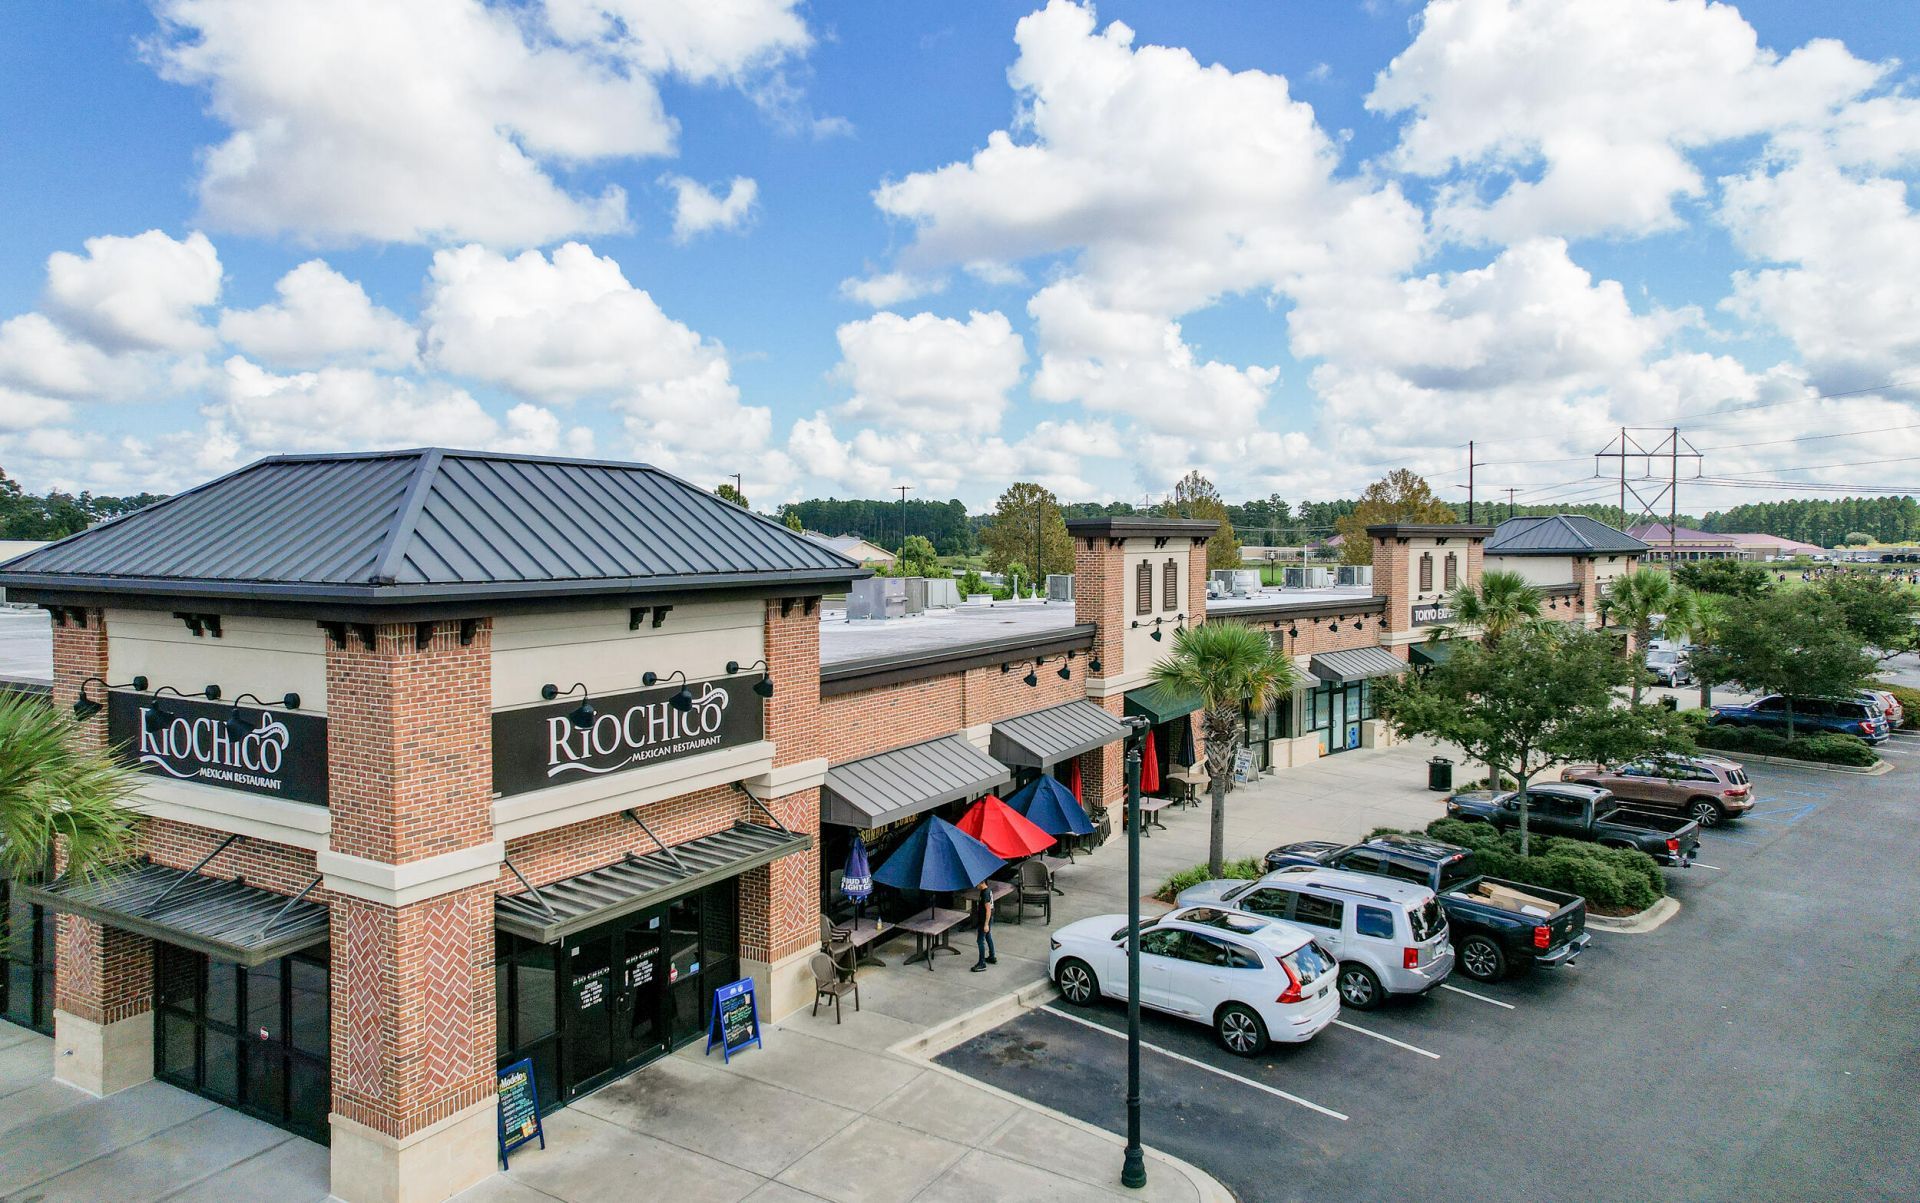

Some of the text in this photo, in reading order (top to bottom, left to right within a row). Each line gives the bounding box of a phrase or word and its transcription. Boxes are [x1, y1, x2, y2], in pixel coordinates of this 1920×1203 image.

[1415, 609, 1437, 621] TOKYO
[632, 735, 722, 762] MEXICAN RESTAURANT
[200, 767, 282, 790] MEXICAN RESTAURANT
[501, 1072, 523, 1088] Modelo
